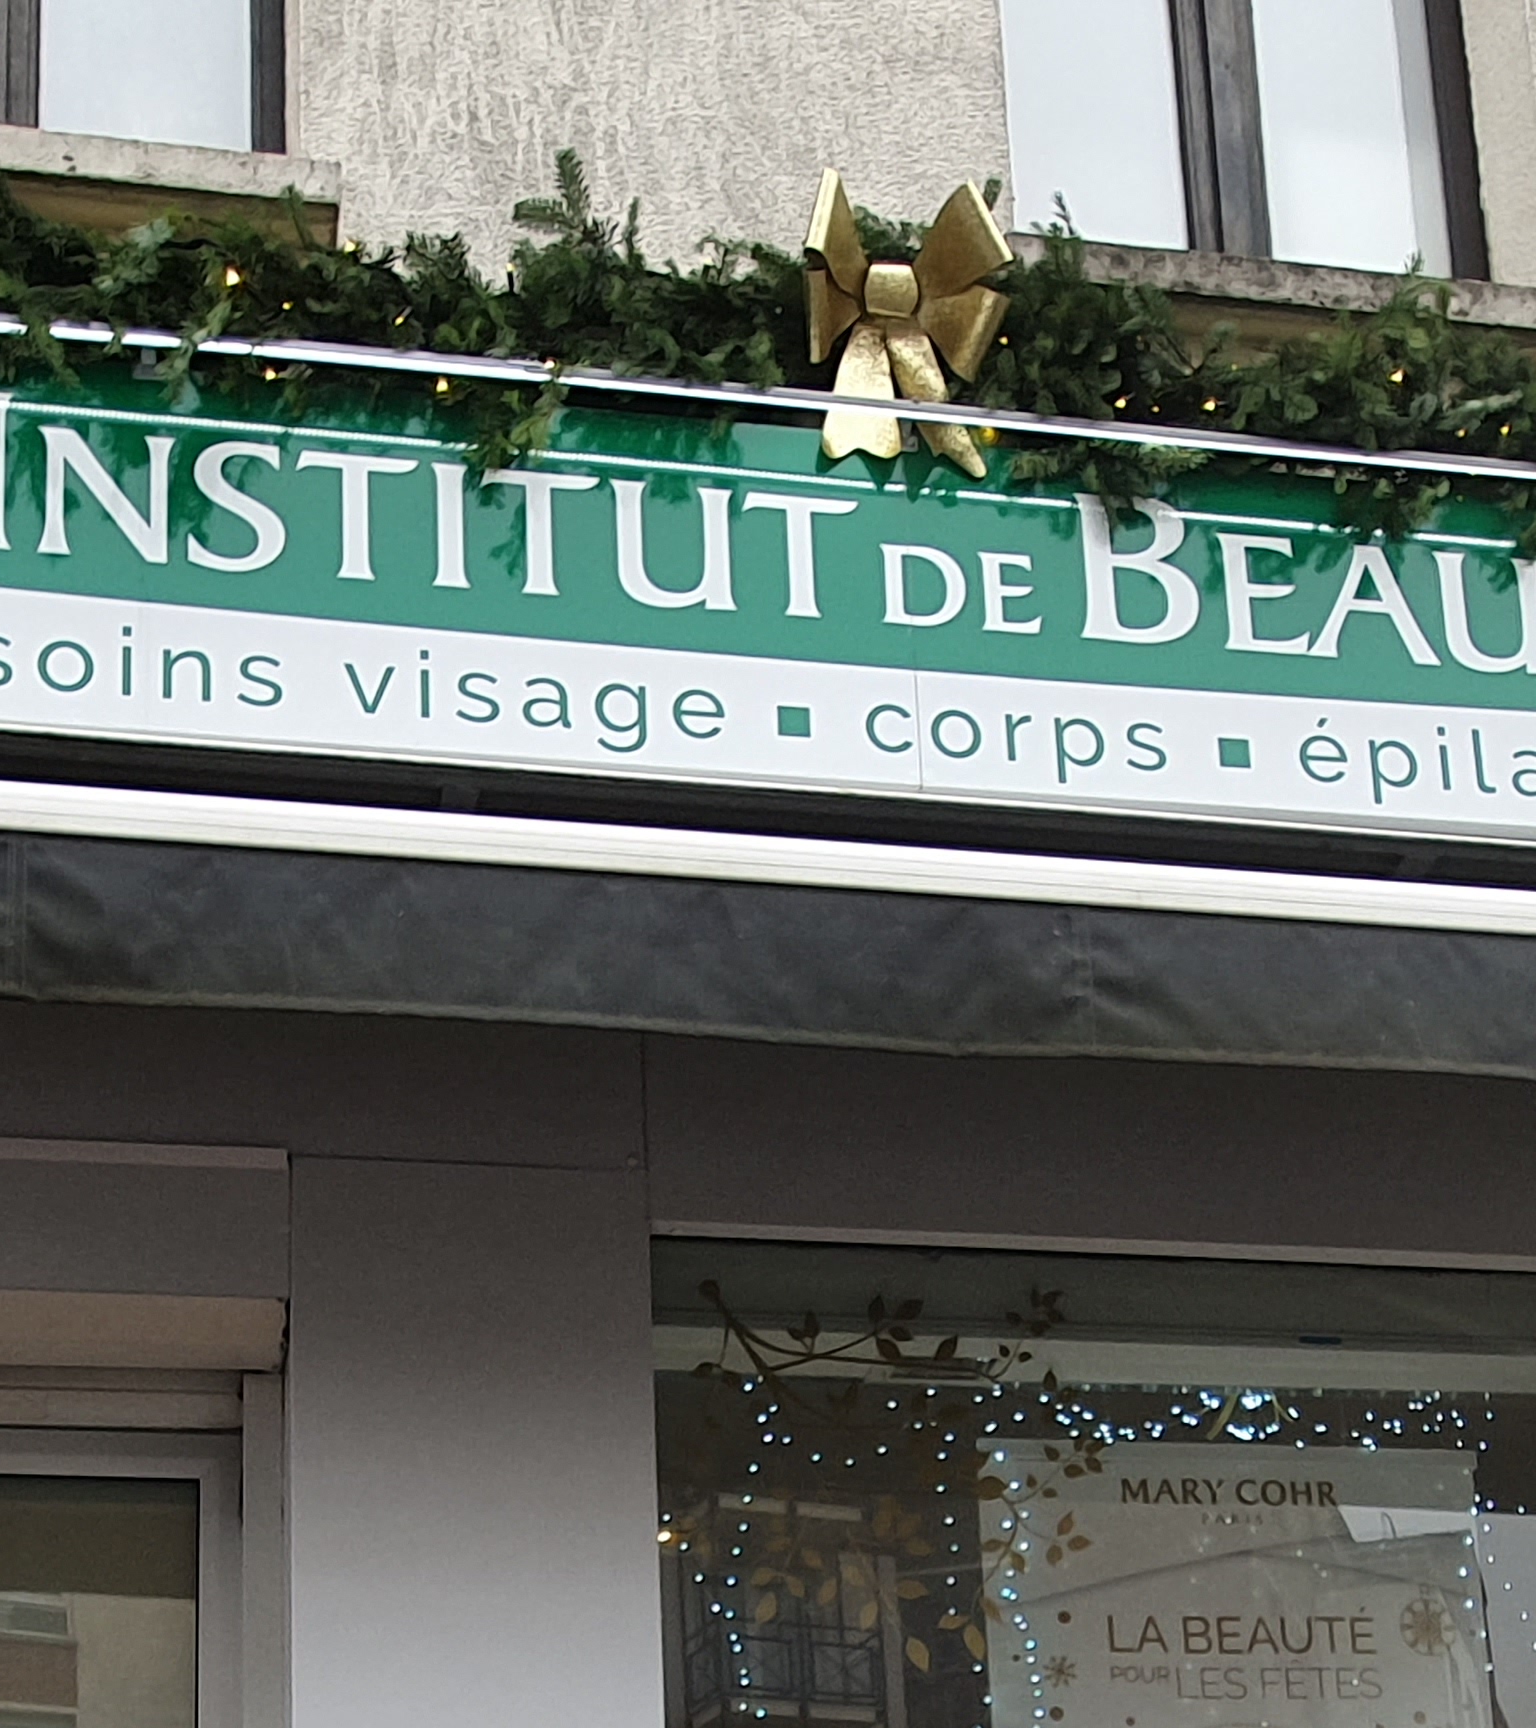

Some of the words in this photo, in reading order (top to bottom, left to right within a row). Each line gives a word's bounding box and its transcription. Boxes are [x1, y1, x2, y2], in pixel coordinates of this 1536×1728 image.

[879, 542, 1043, 635] DE
[344, 650, 727, 753] visage
[864, 702, 1168, 784] corps
[1119, 1477, 1224, 1506] MARY
[1235, 1478, 1339, 1508] COHR
[1106, 1614, 1169, 1654] LA
[1181, 1606, 1378, 1656] BEAUTÉ
[1110, 1665, 1170, 1685] POUR
[1175, 1665, 1248, 1701] LES
[1260, 1660, 1383, 1700] FÊTES
